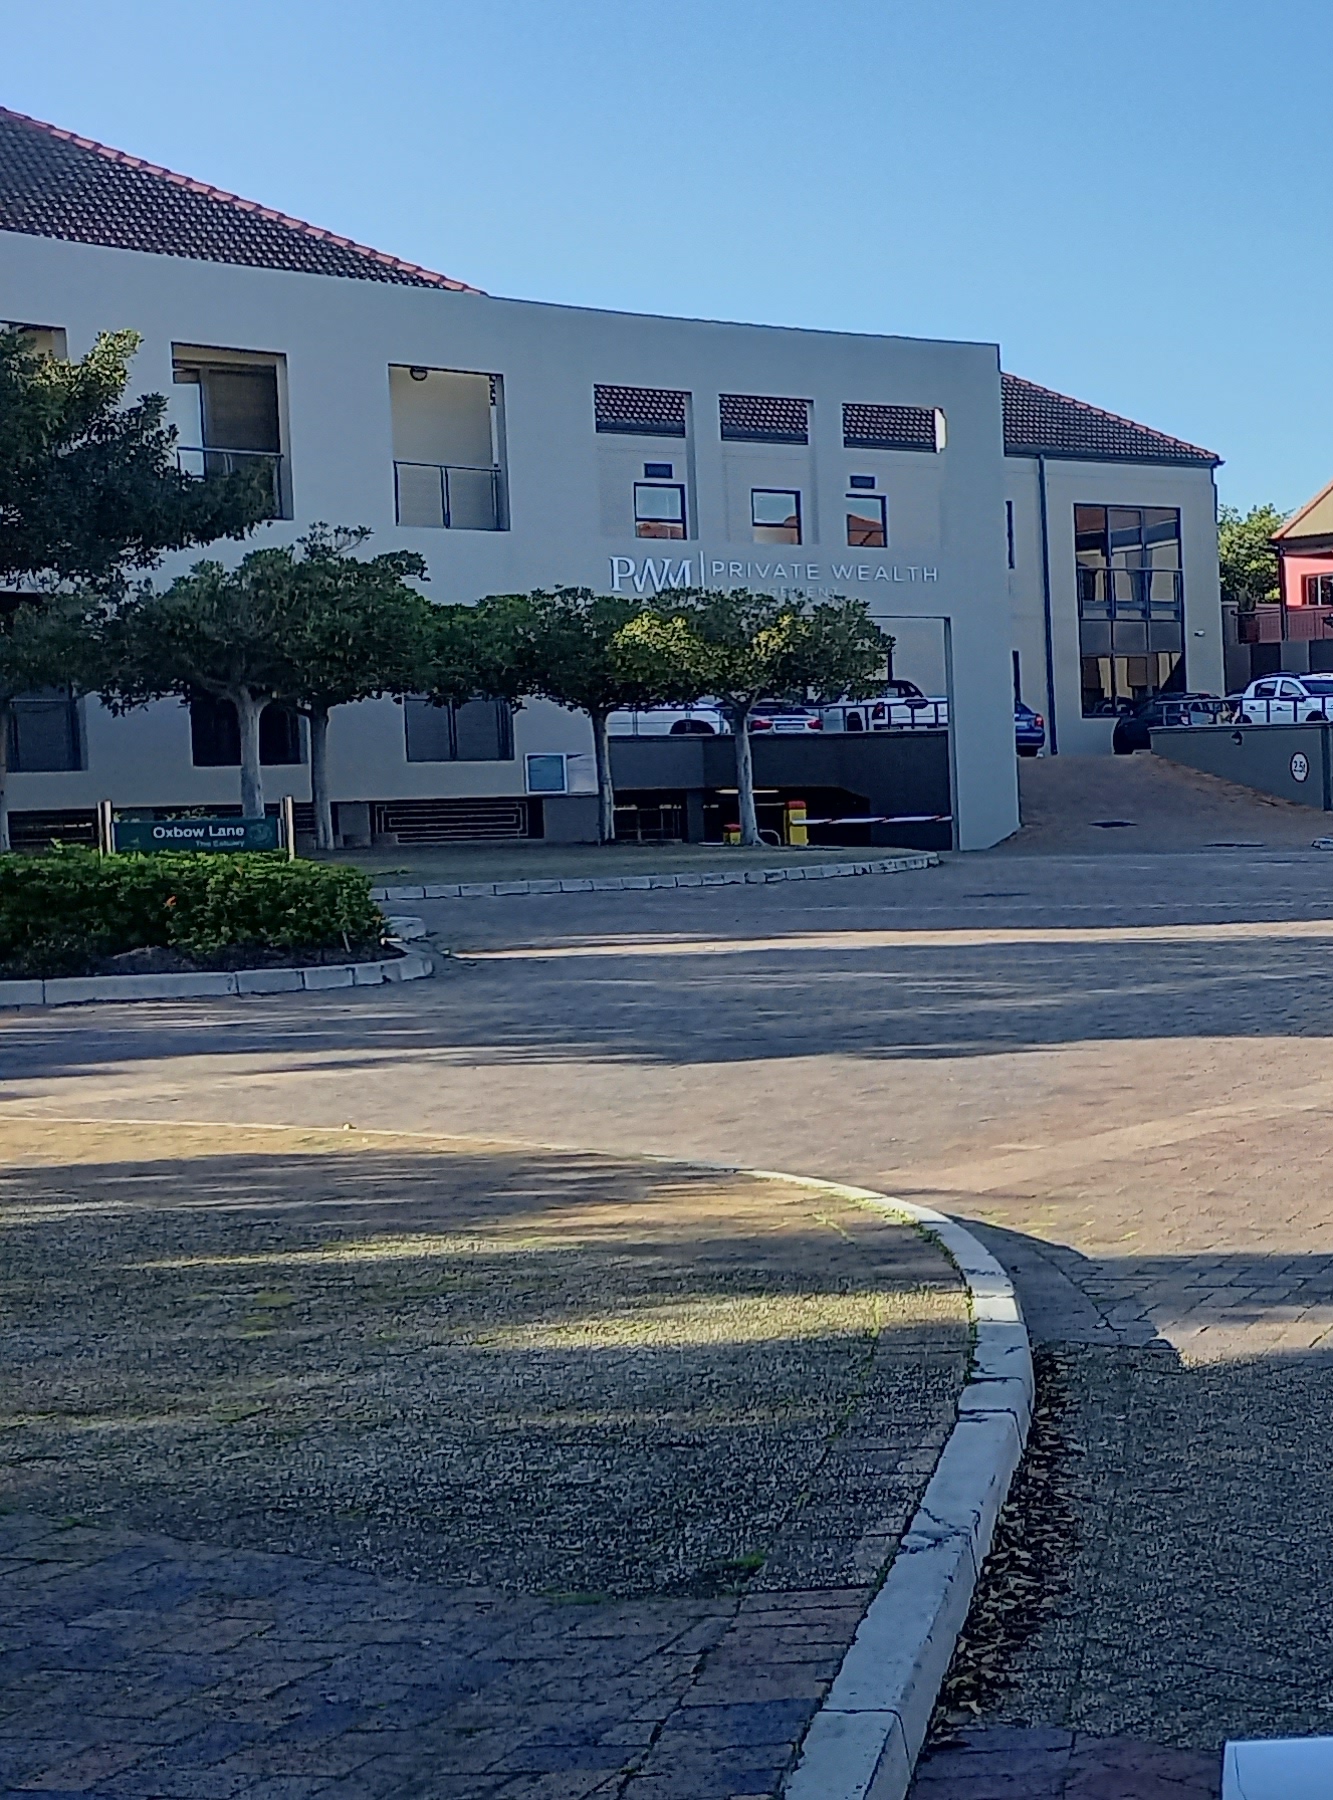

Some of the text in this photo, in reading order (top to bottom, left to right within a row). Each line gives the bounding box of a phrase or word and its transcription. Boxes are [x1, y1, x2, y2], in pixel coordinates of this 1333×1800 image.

[609, 556, 692, 592] PWM
[711, 561, 938, 582] PRIVATE WEALTH
[153, 825, 245, 839] Oxbow Lane
